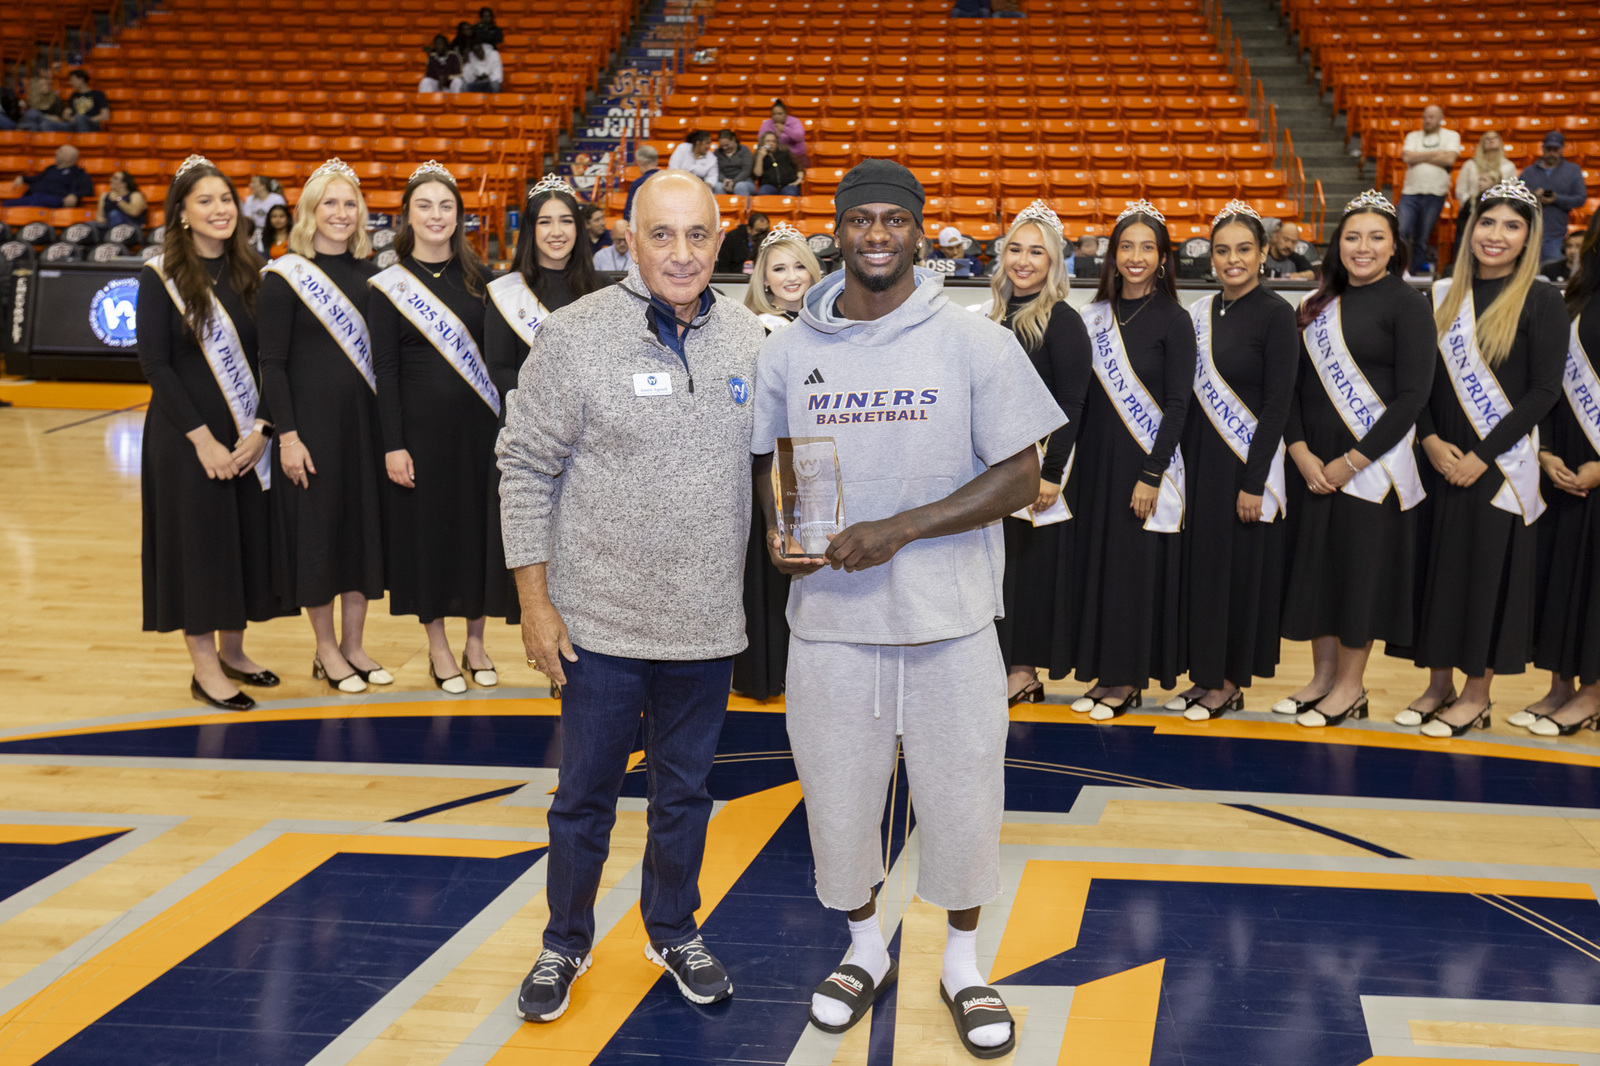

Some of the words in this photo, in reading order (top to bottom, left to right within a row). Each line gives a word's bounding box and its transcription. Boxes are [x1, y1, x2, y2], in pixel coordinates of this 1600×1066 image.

[921, 259, 956, 272] OSS
[301, 274, 331, 305] 2025
[328, 304, 357, 337] SUN
[407, 293, 438, 322] 2025
[434, 319, 464, 352] SUN
[1096, 327, 1113, 358] 2025
[1449, 334, 1470, 370] SUN
[217, 345, 255, 417] PRINCESS
[1104, 358, 1128, 393] SUN
[1315, 328, 1334, 360] SUN
[1327, 359, 1375, 432] PRINCES
[807, 387, 939, 411] MINERS
[816, 408, 928, 425] BASKETBALL
[1202, 378, 1254, 448] PRINCES
